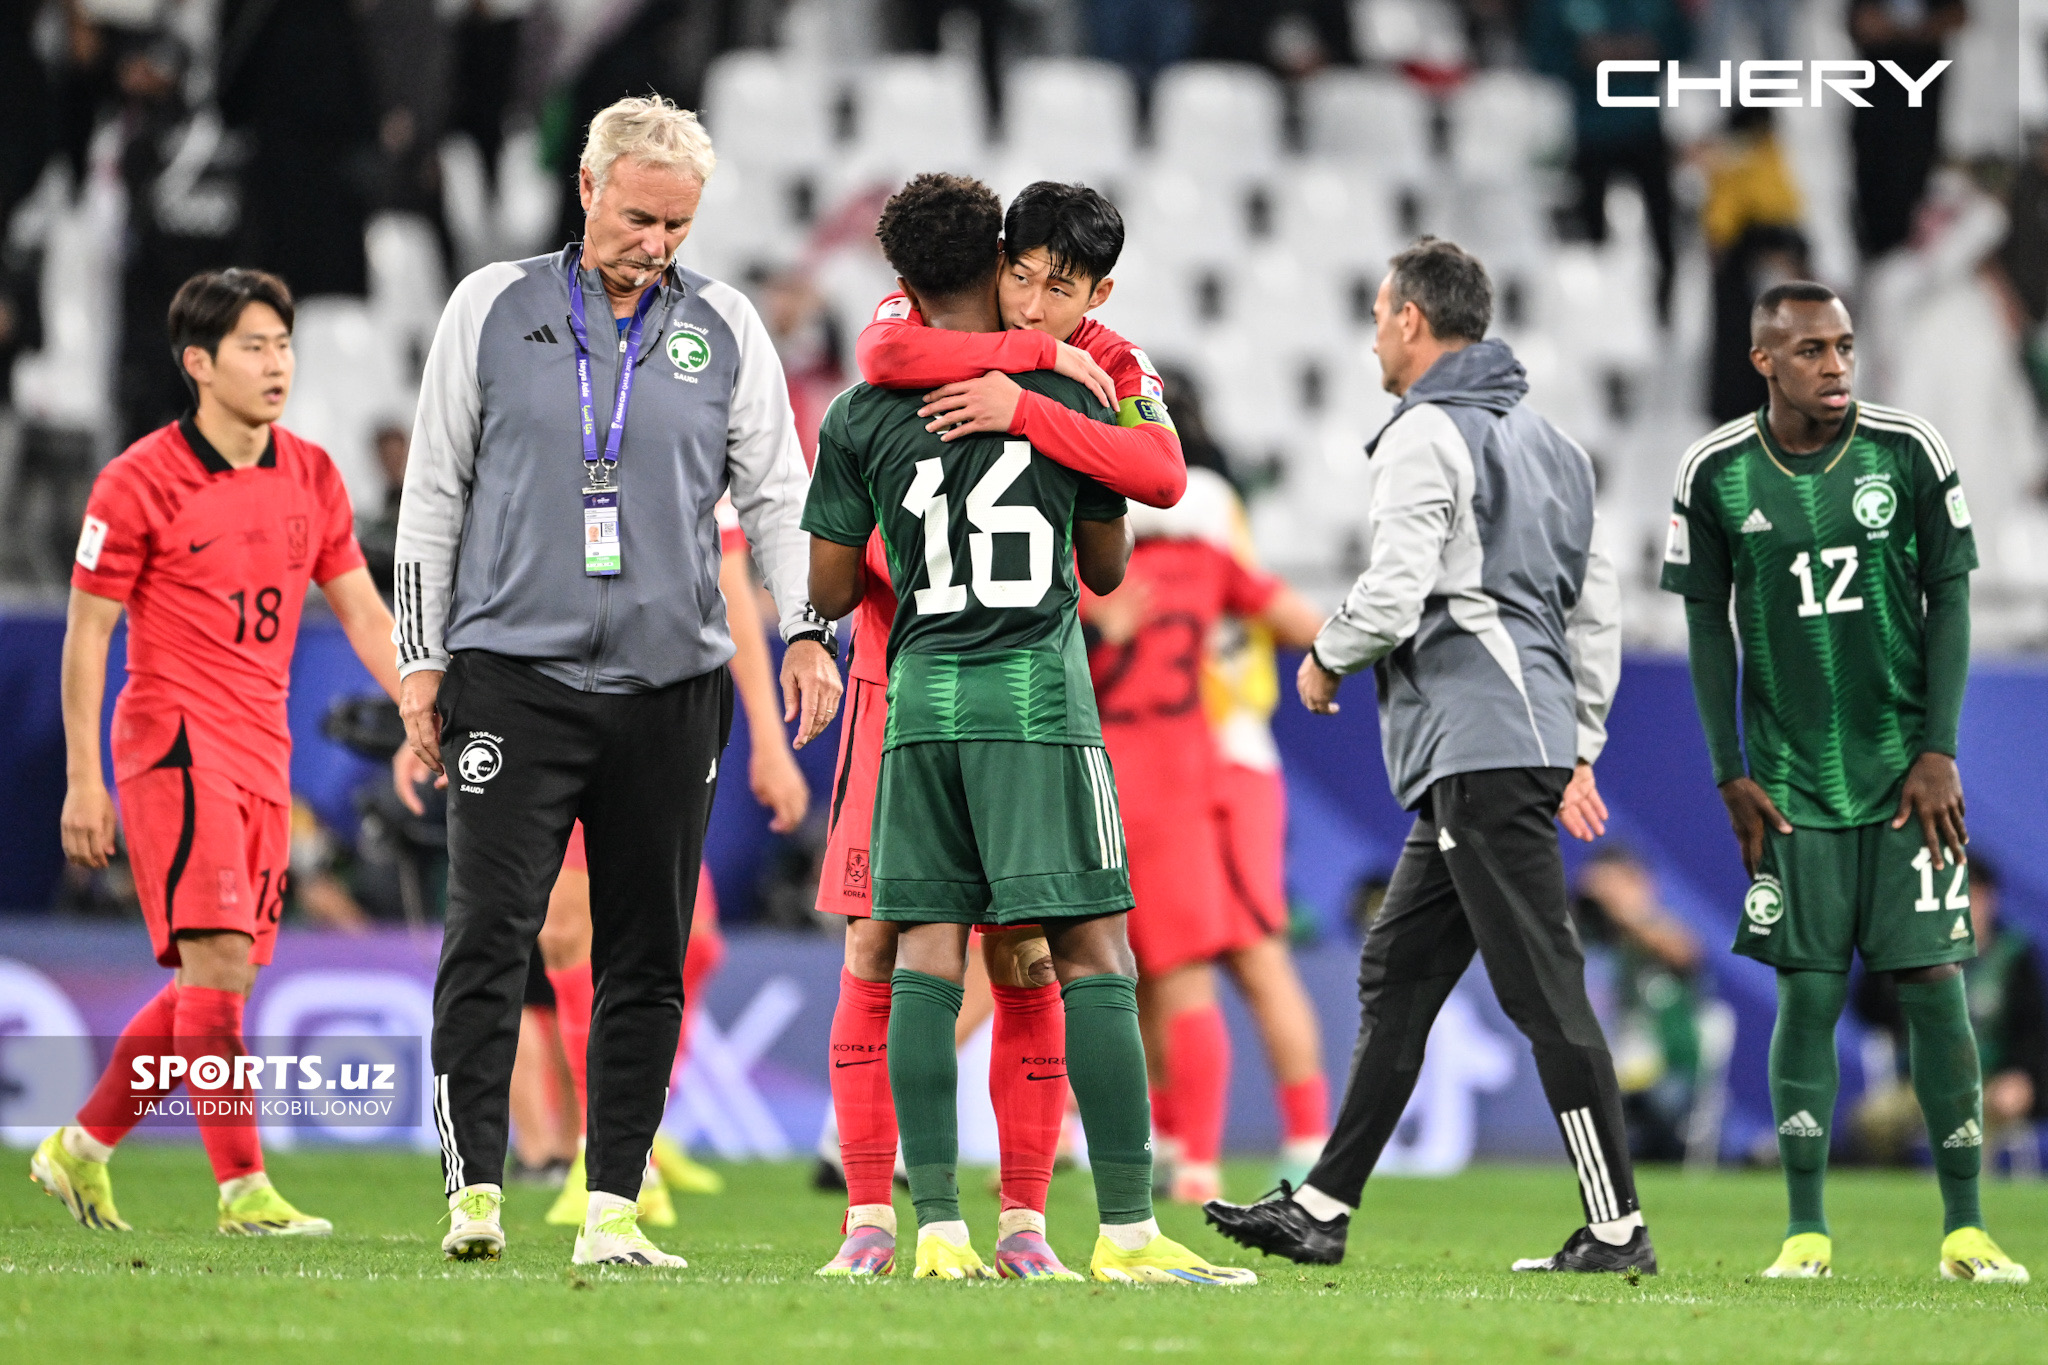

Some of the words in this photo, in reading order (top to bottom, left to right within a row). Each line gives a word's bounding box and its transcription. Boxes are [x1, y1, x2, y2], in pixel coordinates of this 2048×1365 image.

[579, 359, 588, 381] Hayya
[673, 372, 698, 384] SAUDI
[581, 381, 590, 397] Asia
[901, 440, 1054, 616] 16
[1789, 545, 1864, 617] 12
[229, 586, 282, 644] 18
[460, 784, 484, 794] SAUDI
[1911, 846, 1970, 912] 12
[843, 889, 867, 899] KOREA
[833, 1043, 887, 1053] KOREA
[1779, 1125, 1824, 1137] adidas
